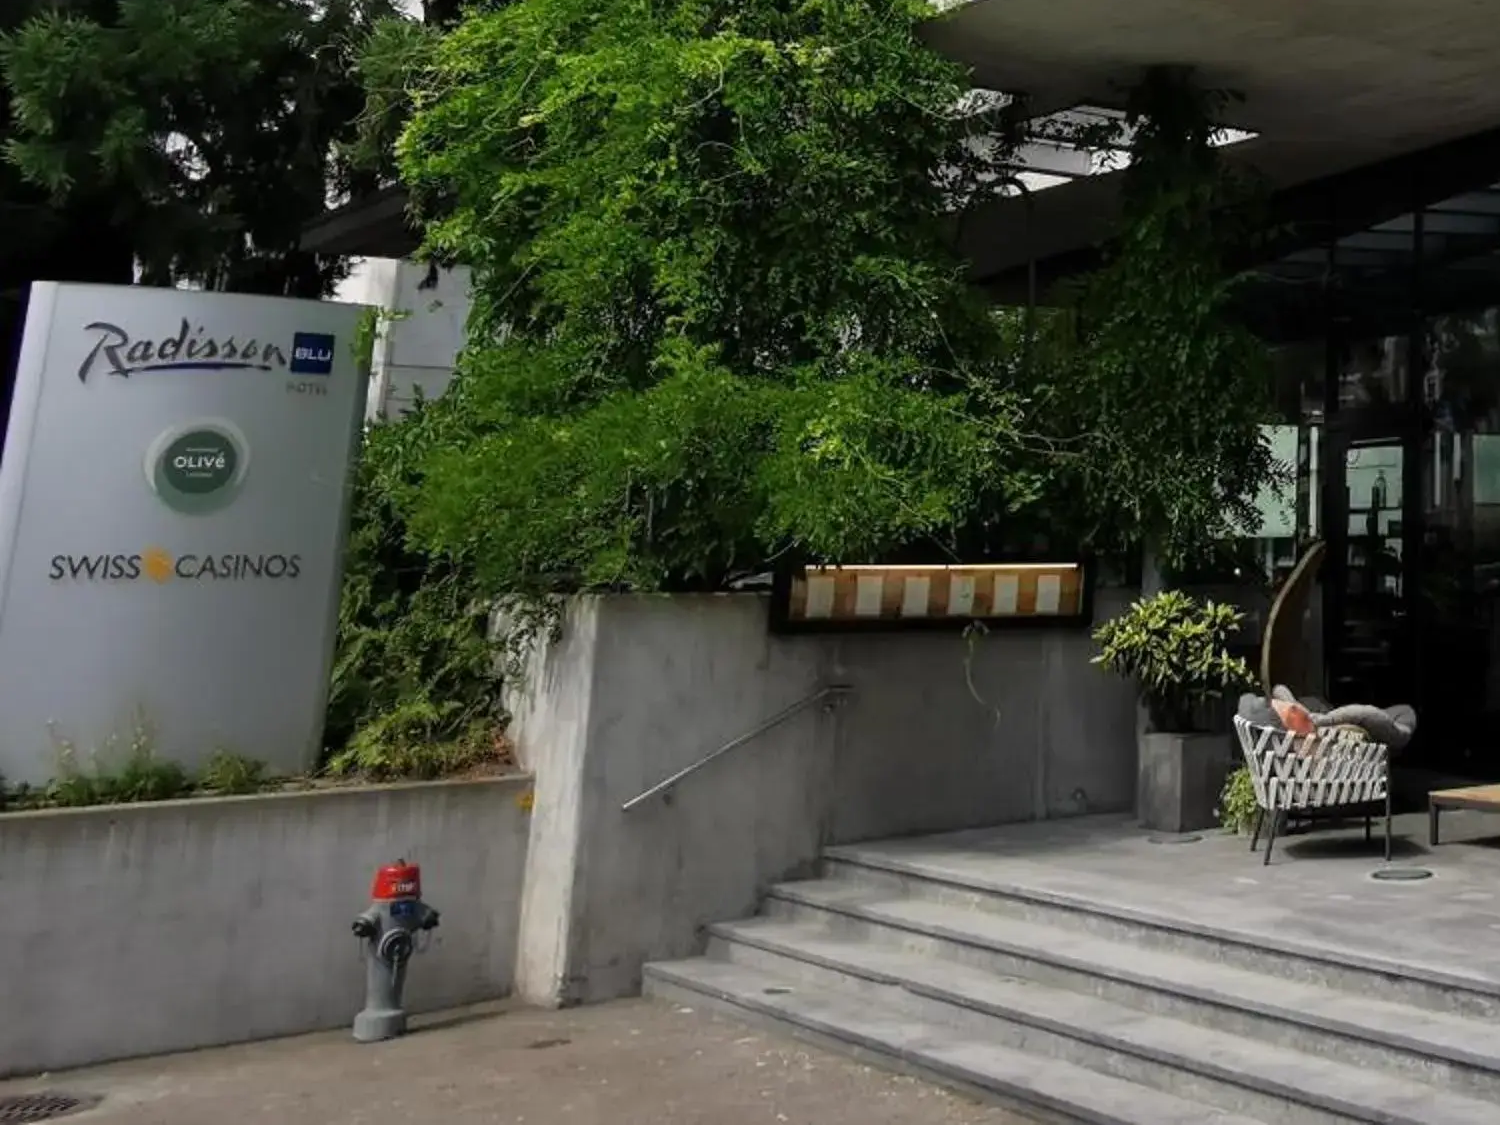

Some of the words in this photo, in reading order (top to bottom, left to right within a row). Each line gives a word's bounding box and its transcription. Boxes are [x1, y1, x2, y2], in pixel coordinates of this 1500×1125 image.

[78, 316, 287, 384] Radisson
[295, 346, 332, 362] BLU
[49, 554, 142, 580] SWISS
[175, 554, 301, 581] CASINOS
